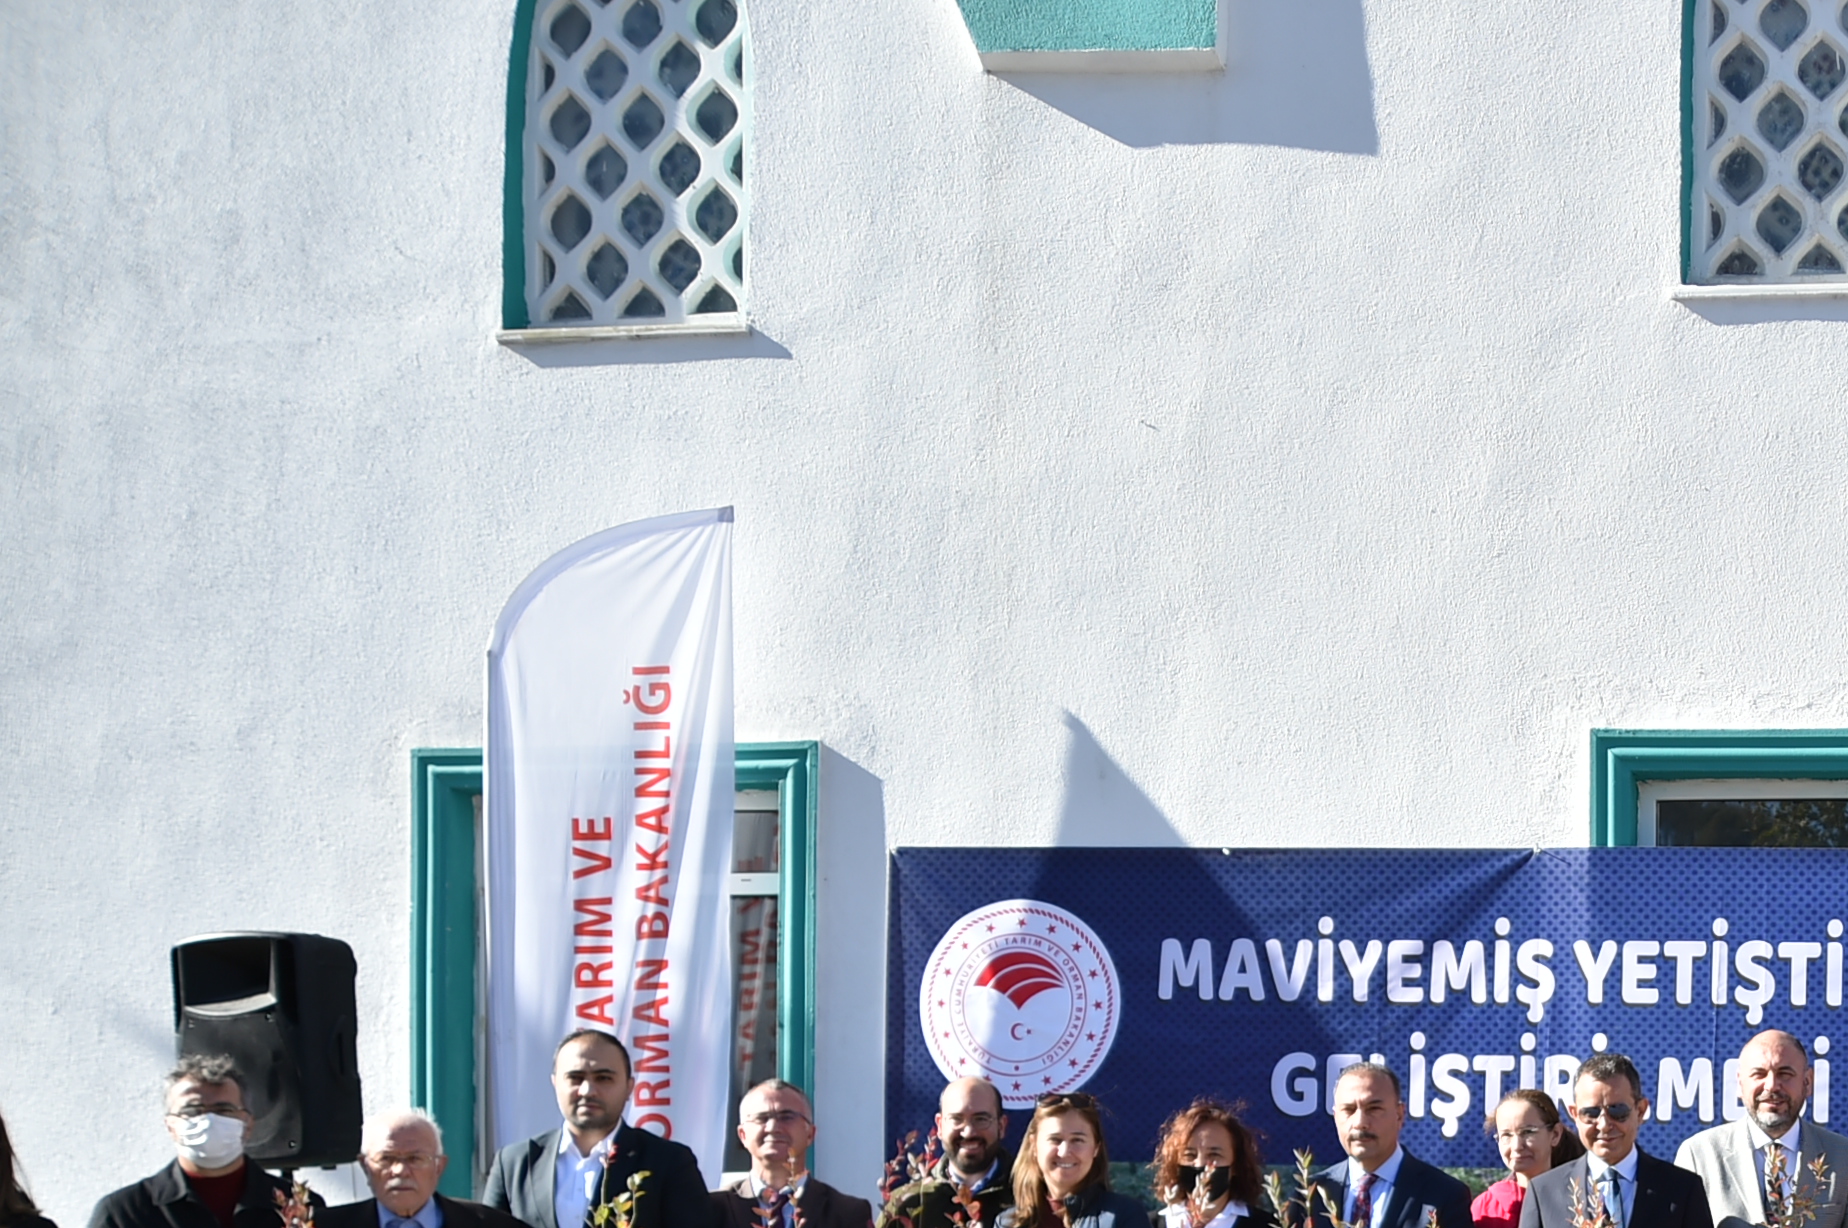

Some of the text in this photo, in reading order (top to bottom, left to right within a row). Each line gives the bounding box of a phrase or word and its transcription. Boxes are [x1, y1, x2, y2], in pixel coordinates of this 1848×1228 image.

[572, 817, 617, 1033] ARIM VE
[624, 665, 674, 1141] ORMAN BAKANLIĞI
[1004, 936, 1044, 948] TARIM
[1047, 944, 1060, 958] VE
[1158, 915, 1556, 1024] MAVİYEMİŞ
[1062, 958, 1084, 1001] ORMAN
[1041, 1006, 1084, 1066] BAKANLIĞI
